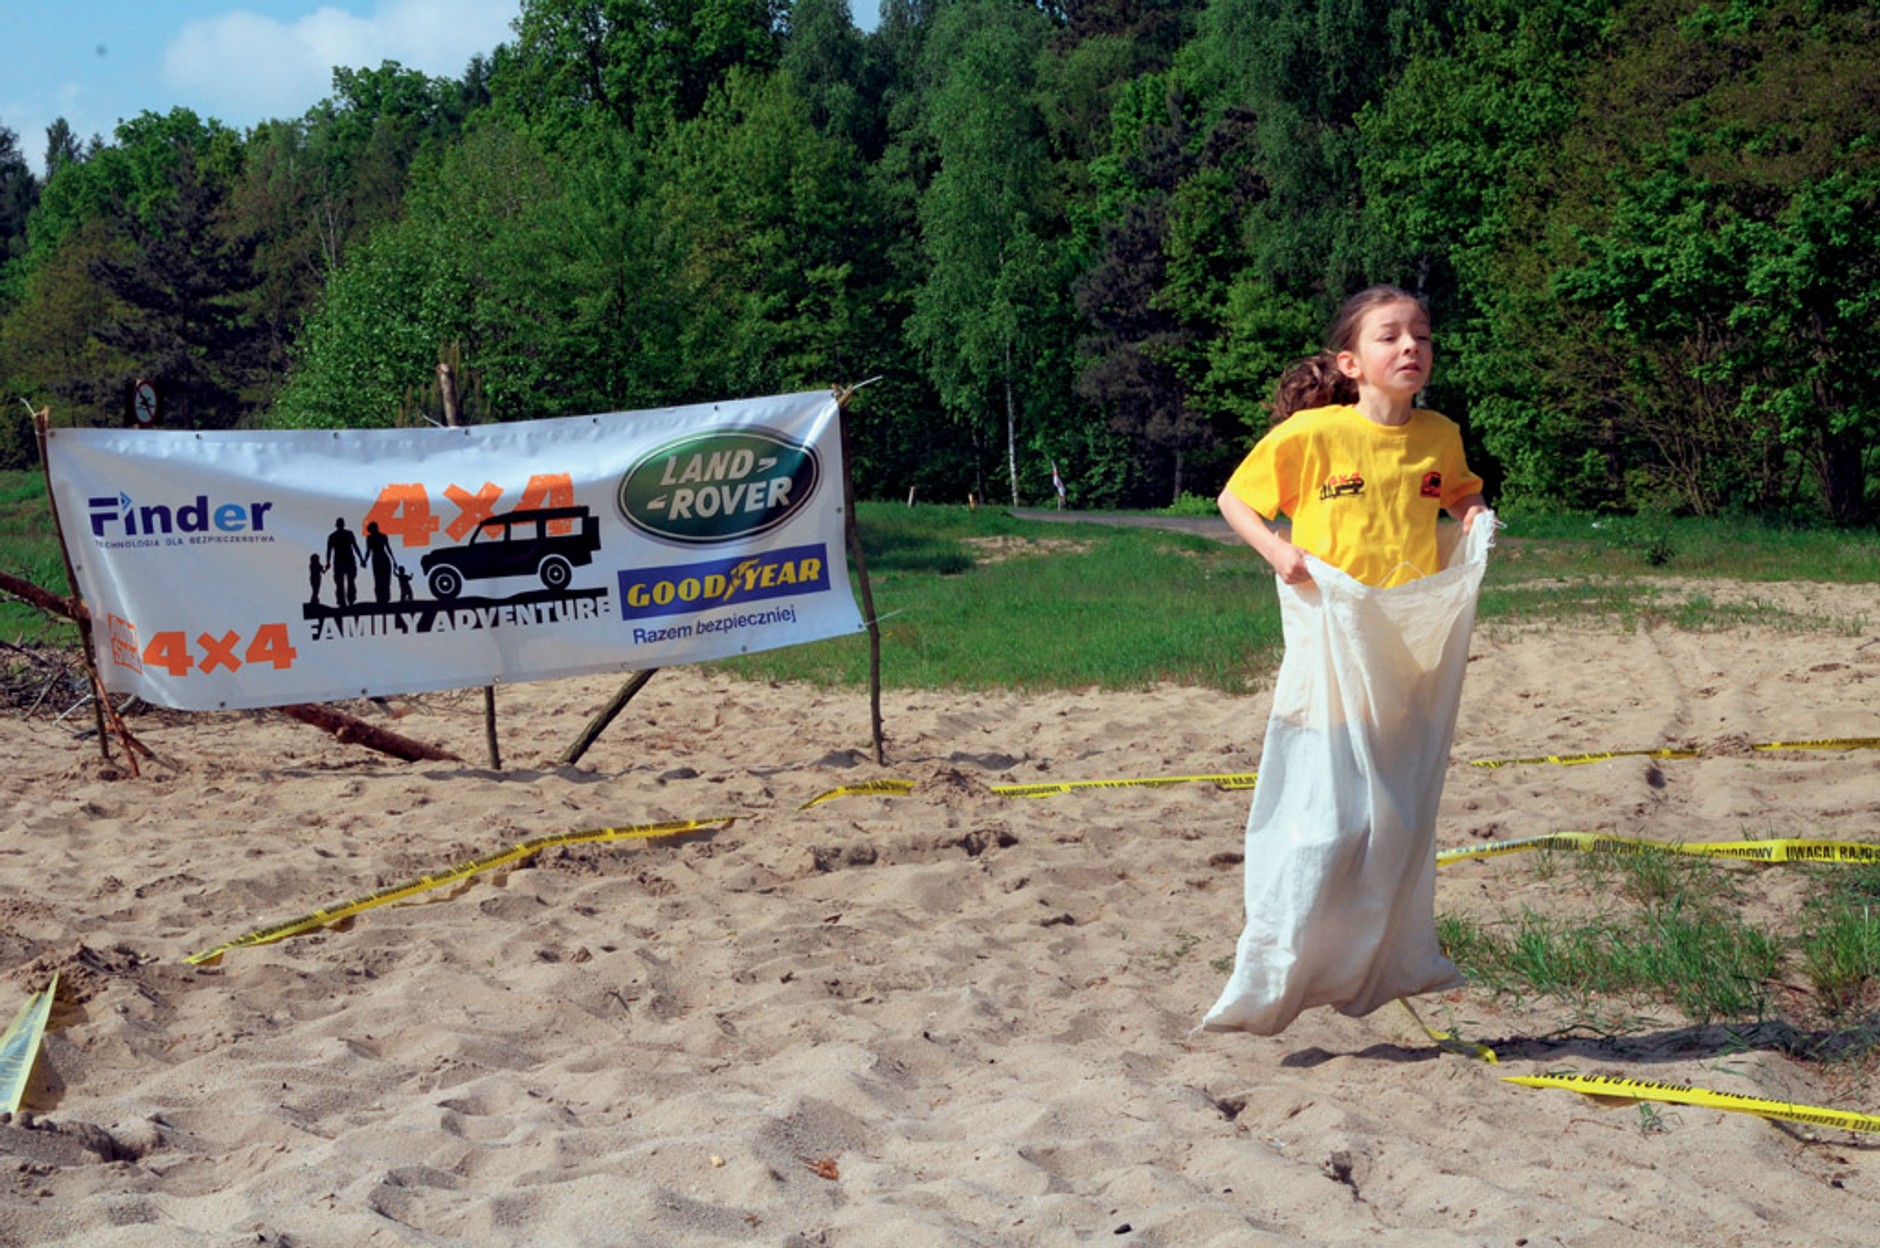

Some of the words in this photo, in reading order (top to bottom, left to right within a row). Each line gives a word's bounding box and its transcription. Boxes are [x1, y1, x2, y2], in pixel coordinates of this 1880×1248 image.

[660, 449, 755, 486] LAND
[88, 492, 273, 537] Finder
[668, 476, 793, 520] ROVER
[166, 538, 184, 546] DLA
[627, 557, 822, 608] GOODYEAR
[304, 610, 424, 641] FAMILY
[430, 597, 610, 633] ADVENTURE
[633, 624, 693, 645] Razem
[695, 604, 797, 635] bezpieczniej
